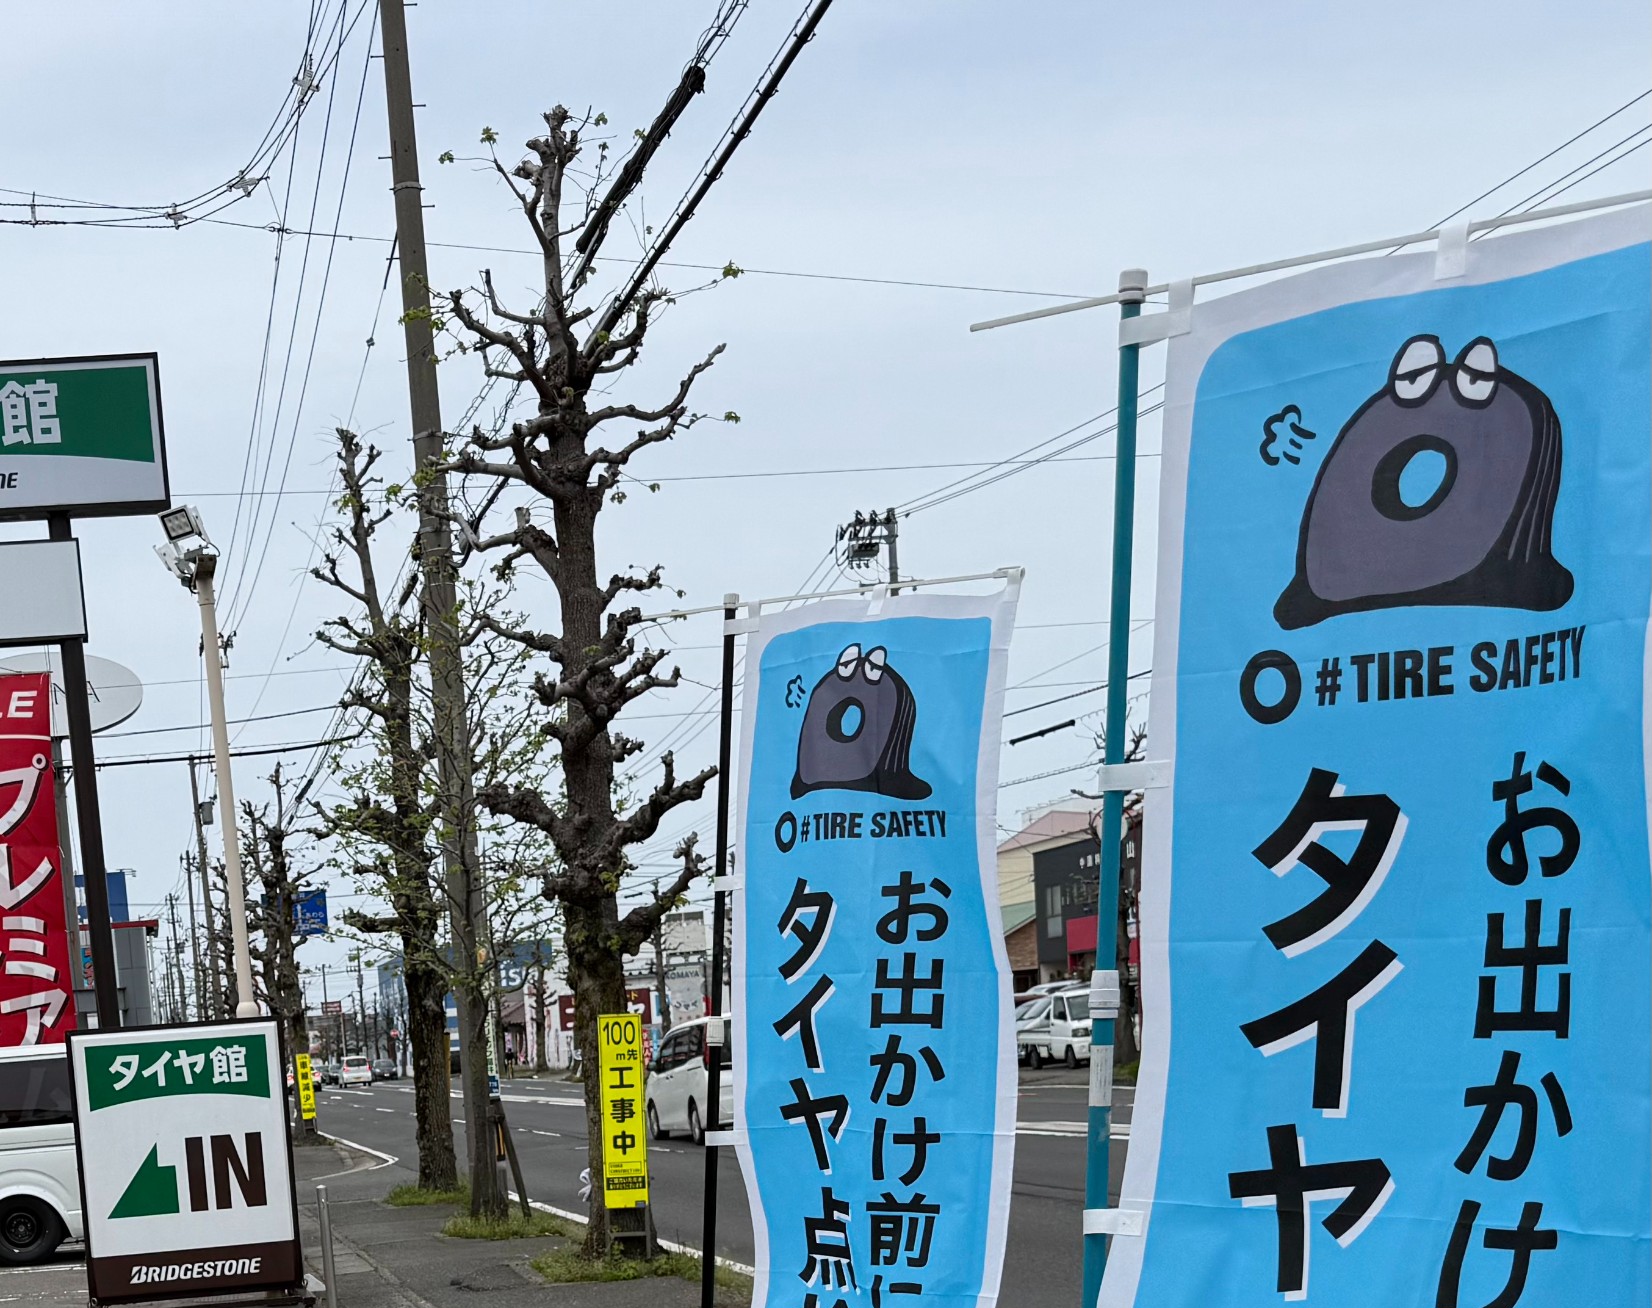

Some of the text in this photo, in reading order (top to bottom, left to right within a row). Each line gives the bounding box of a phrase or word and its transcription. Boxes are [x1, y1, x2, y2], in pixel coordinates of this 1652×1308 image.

[0, 379, 61, 446] 館
[1469, 625, 1586, 694] SAFETY
[870, 810, 947, 838] SAFETY
[602, 1020, 636, 1046] 100
[109, 1044, 248, 1091] タイヤ館
[609, 1066, 636, 1156] 工事中
[185, 1131, 267, 1213] IN
[129, 1257, 262, 1285] BRIDGESTONE
